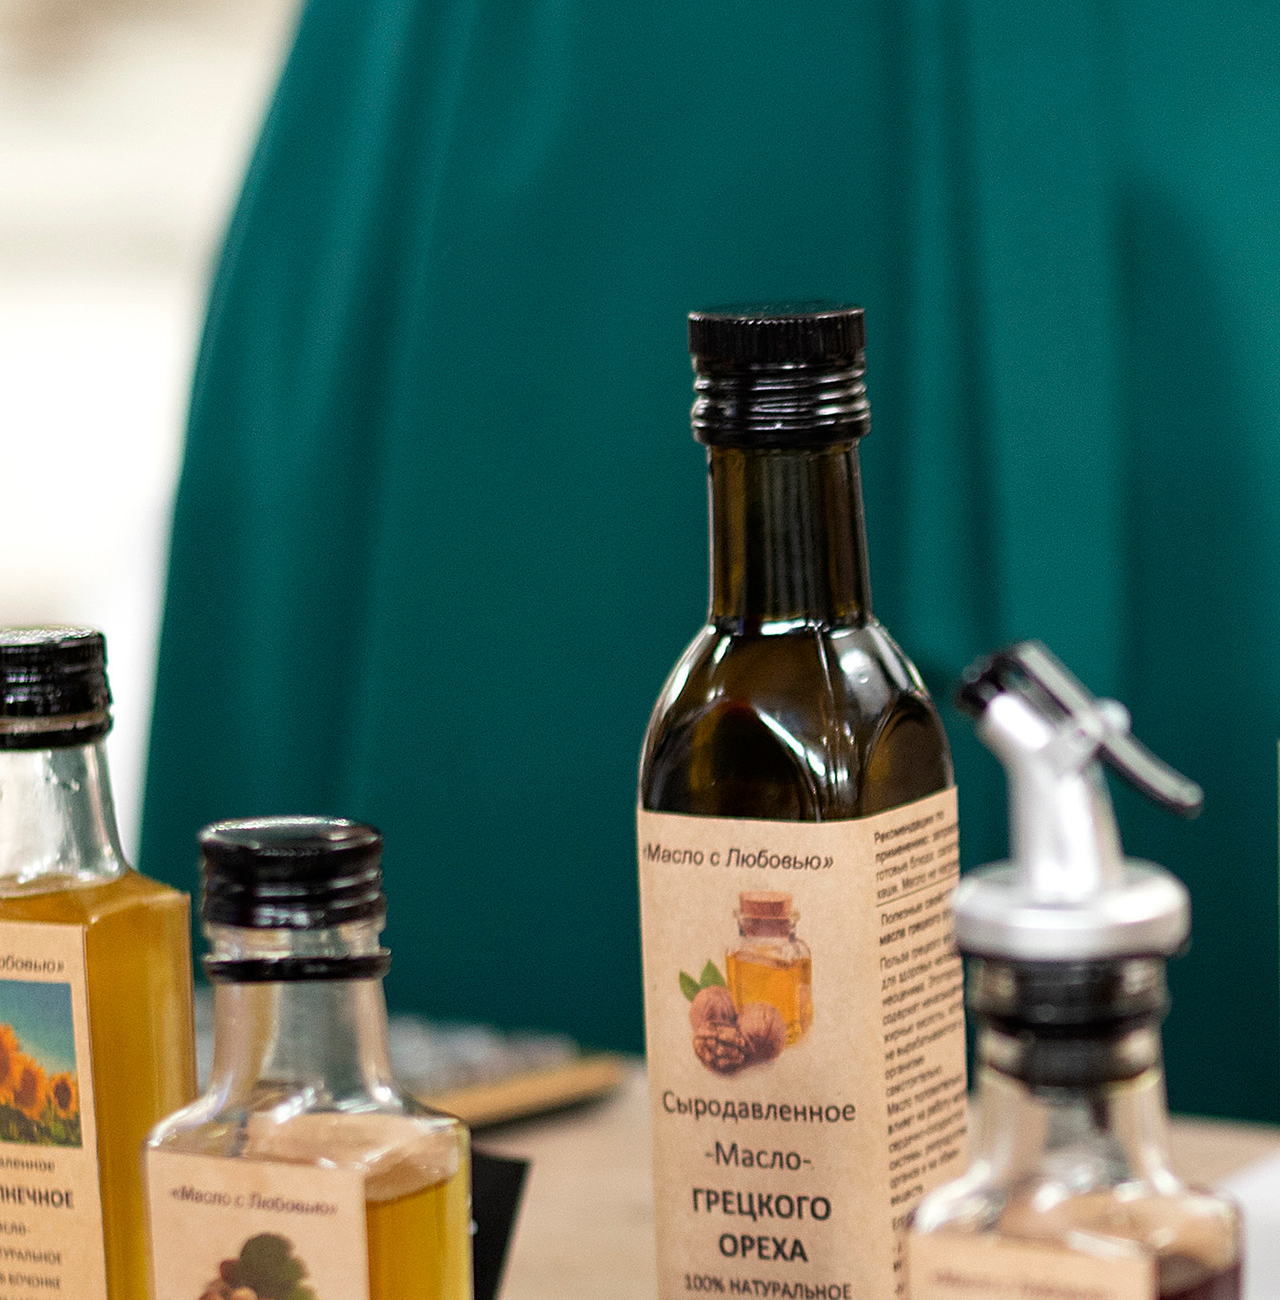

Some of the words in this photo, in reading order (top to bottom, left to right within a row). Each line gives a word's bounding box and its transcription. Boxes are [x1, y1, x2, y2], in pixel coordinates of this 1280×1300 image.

[710, 852, 721, 867] с
[726, 847, 834, 871] Любовью»
[662, 1090, 856, 1124] Сыродавленное
[692, 1187, 832, 1222] ГРЕЦКОГО
[719, 1232, 809, 1263] ОРЕХА
[684, 1273, 726, 1294] 100%
[729, 1277, 852, 1300] НАТУРАЛЬНОЕ
